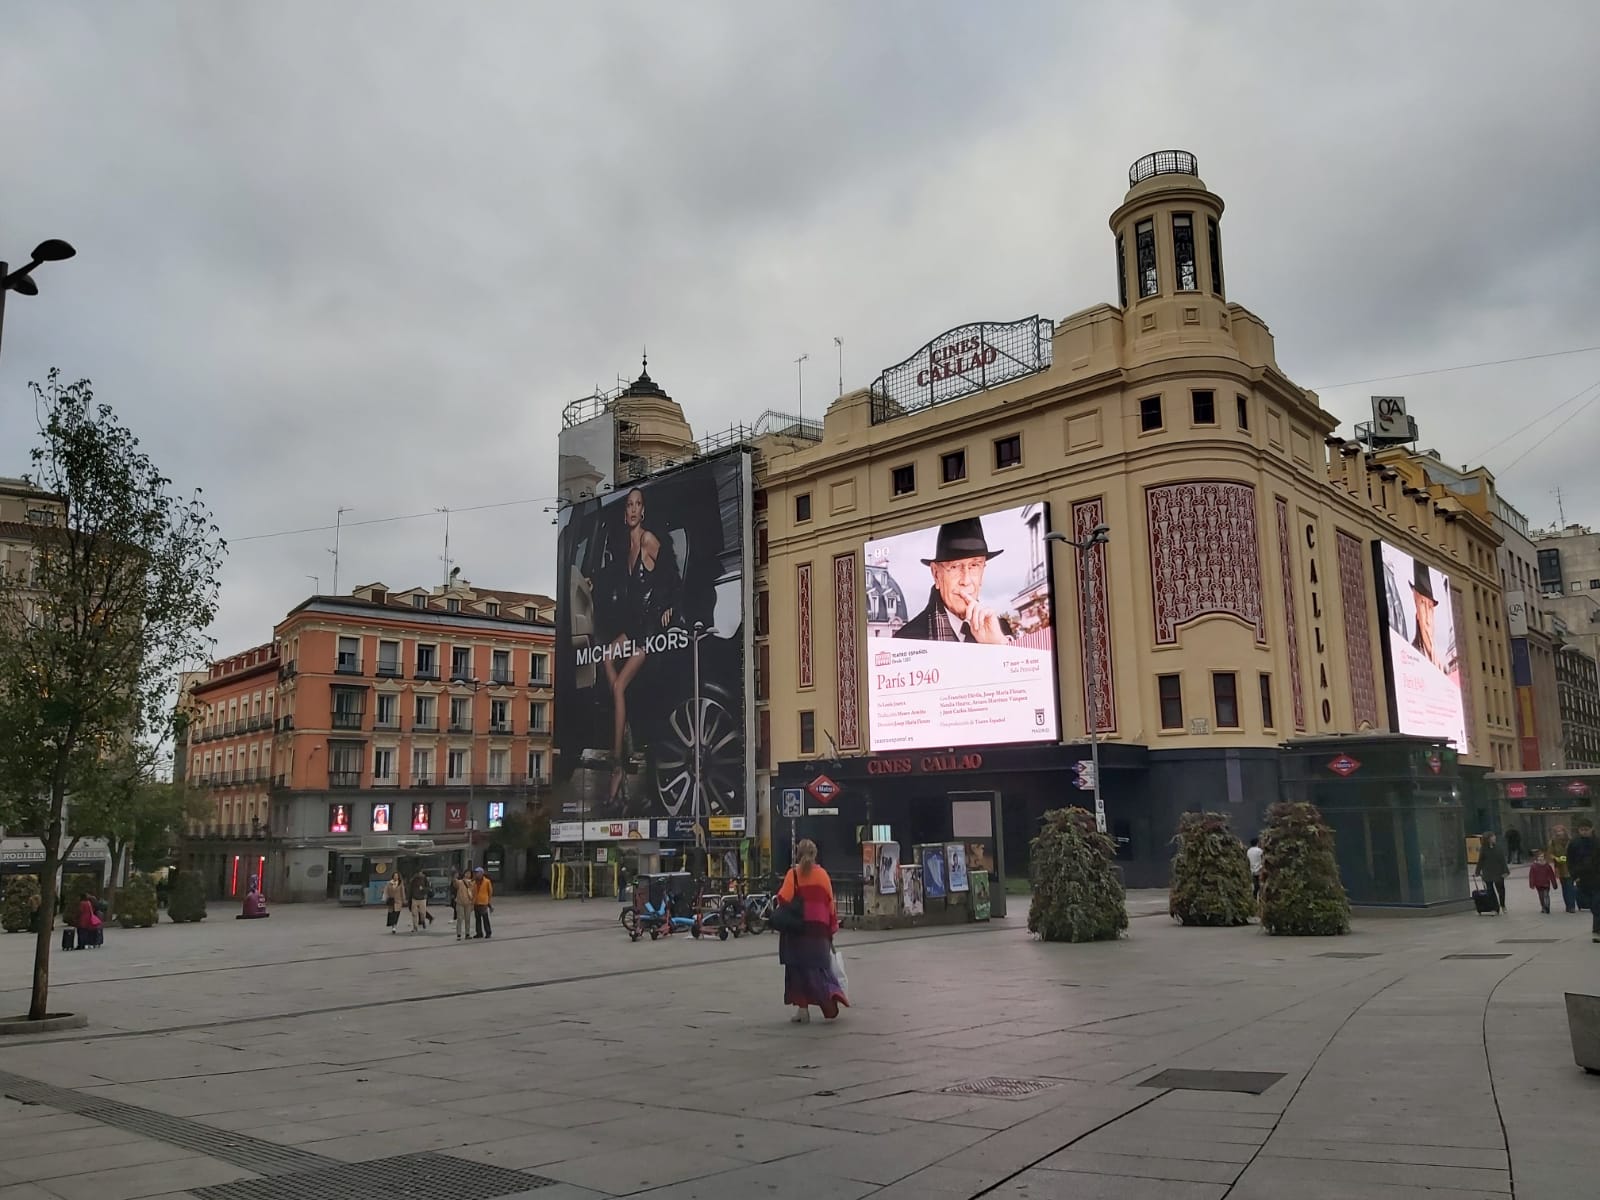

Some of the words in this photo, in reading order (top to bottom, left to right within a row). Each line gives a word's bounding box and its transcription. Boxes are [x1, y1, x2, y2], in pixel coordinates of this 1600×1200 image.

[932, 335, 980, 361] CINES
[916, 346, 997, 387] CALLAO
[1306, 524, 1331, 724] CALLAO
[576, 640, 640, 666] MICHAEL
[645, 633, 689, 655] KORS
[877, 672, 906, 690] París
[909, 668, 940, 686] 1940
[867, 758, 912, 774] CINES
[920, 753, 982, 772] CALLAO
[3, 852, 46, 860] RODILLA
[68, 850, 104, 859] ODILLA
